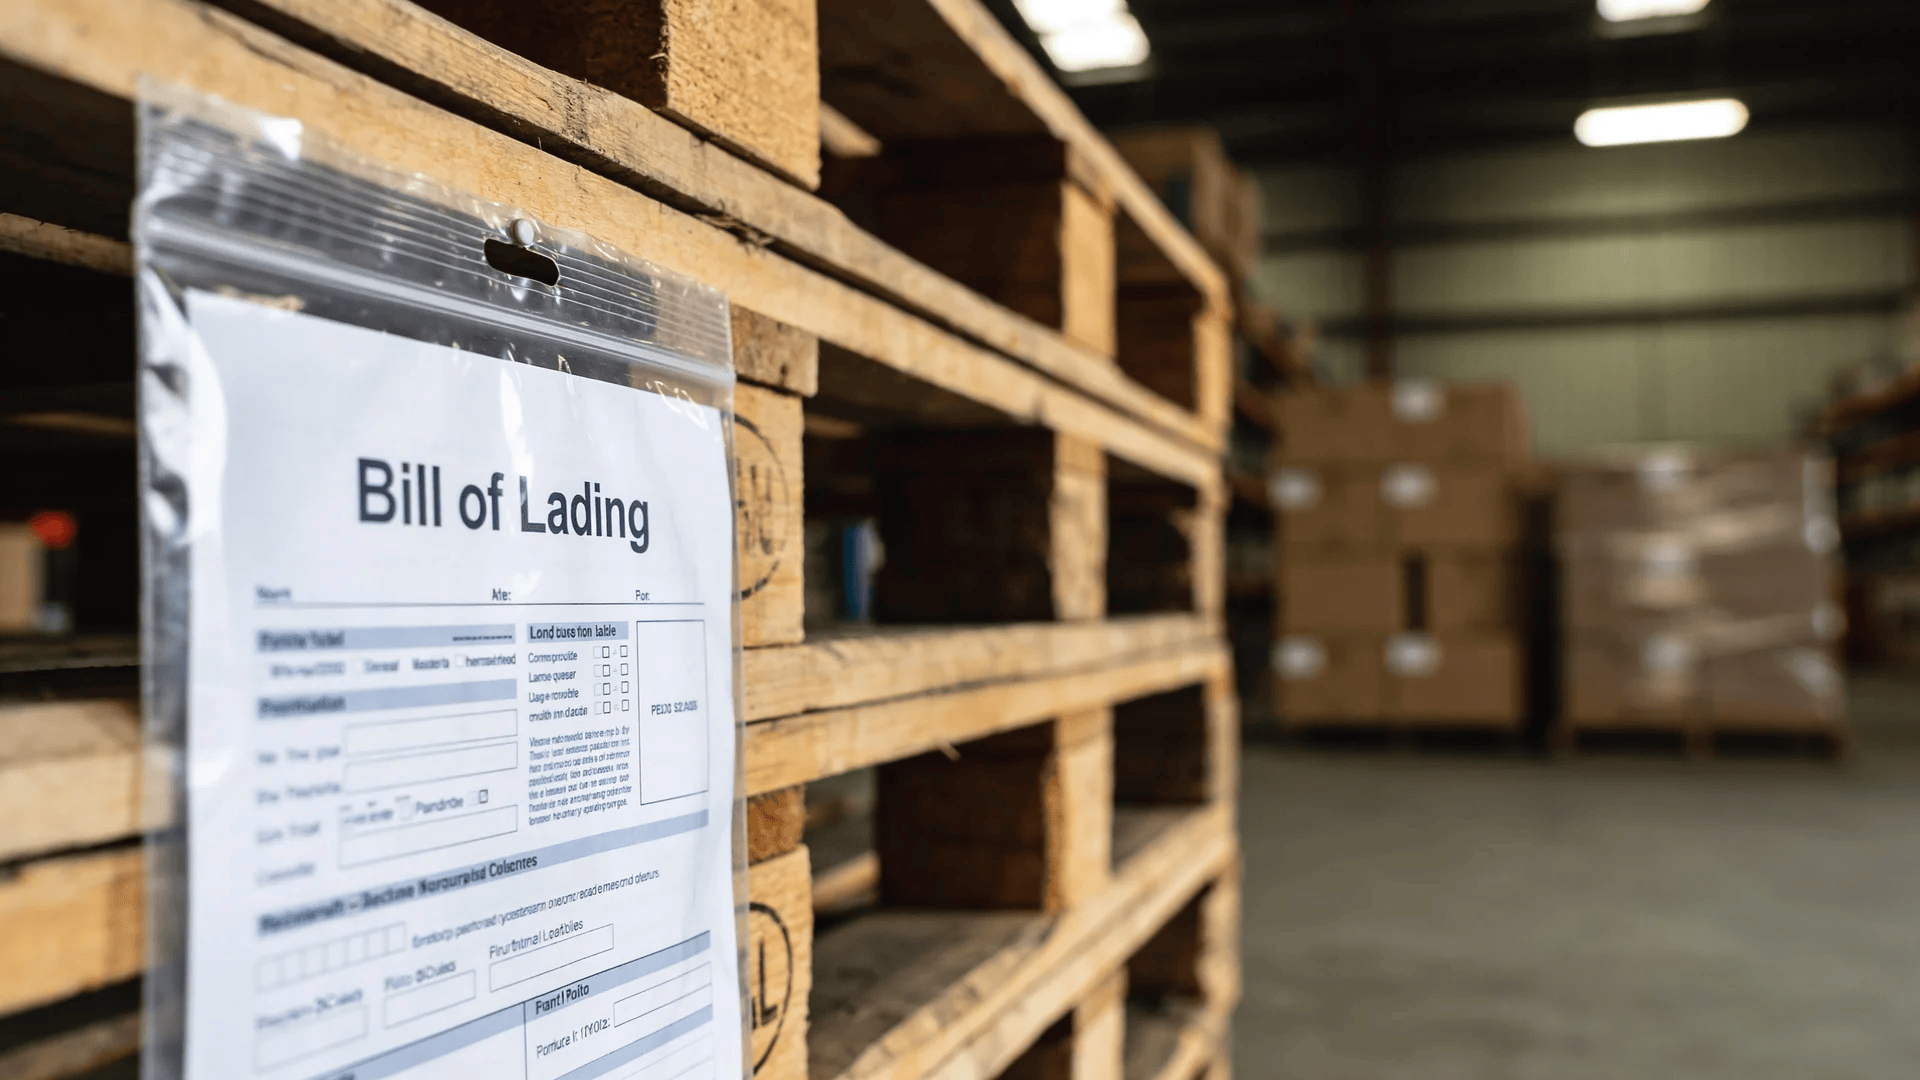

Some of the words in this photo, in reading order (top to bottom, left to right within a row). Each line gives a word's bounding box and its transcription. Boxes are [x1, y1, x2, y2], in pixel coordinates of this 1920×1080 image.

[357, 457, 442, 527] Bill
[459, 472, 505, 531] of
[520, 475, 650, 554] Lading
